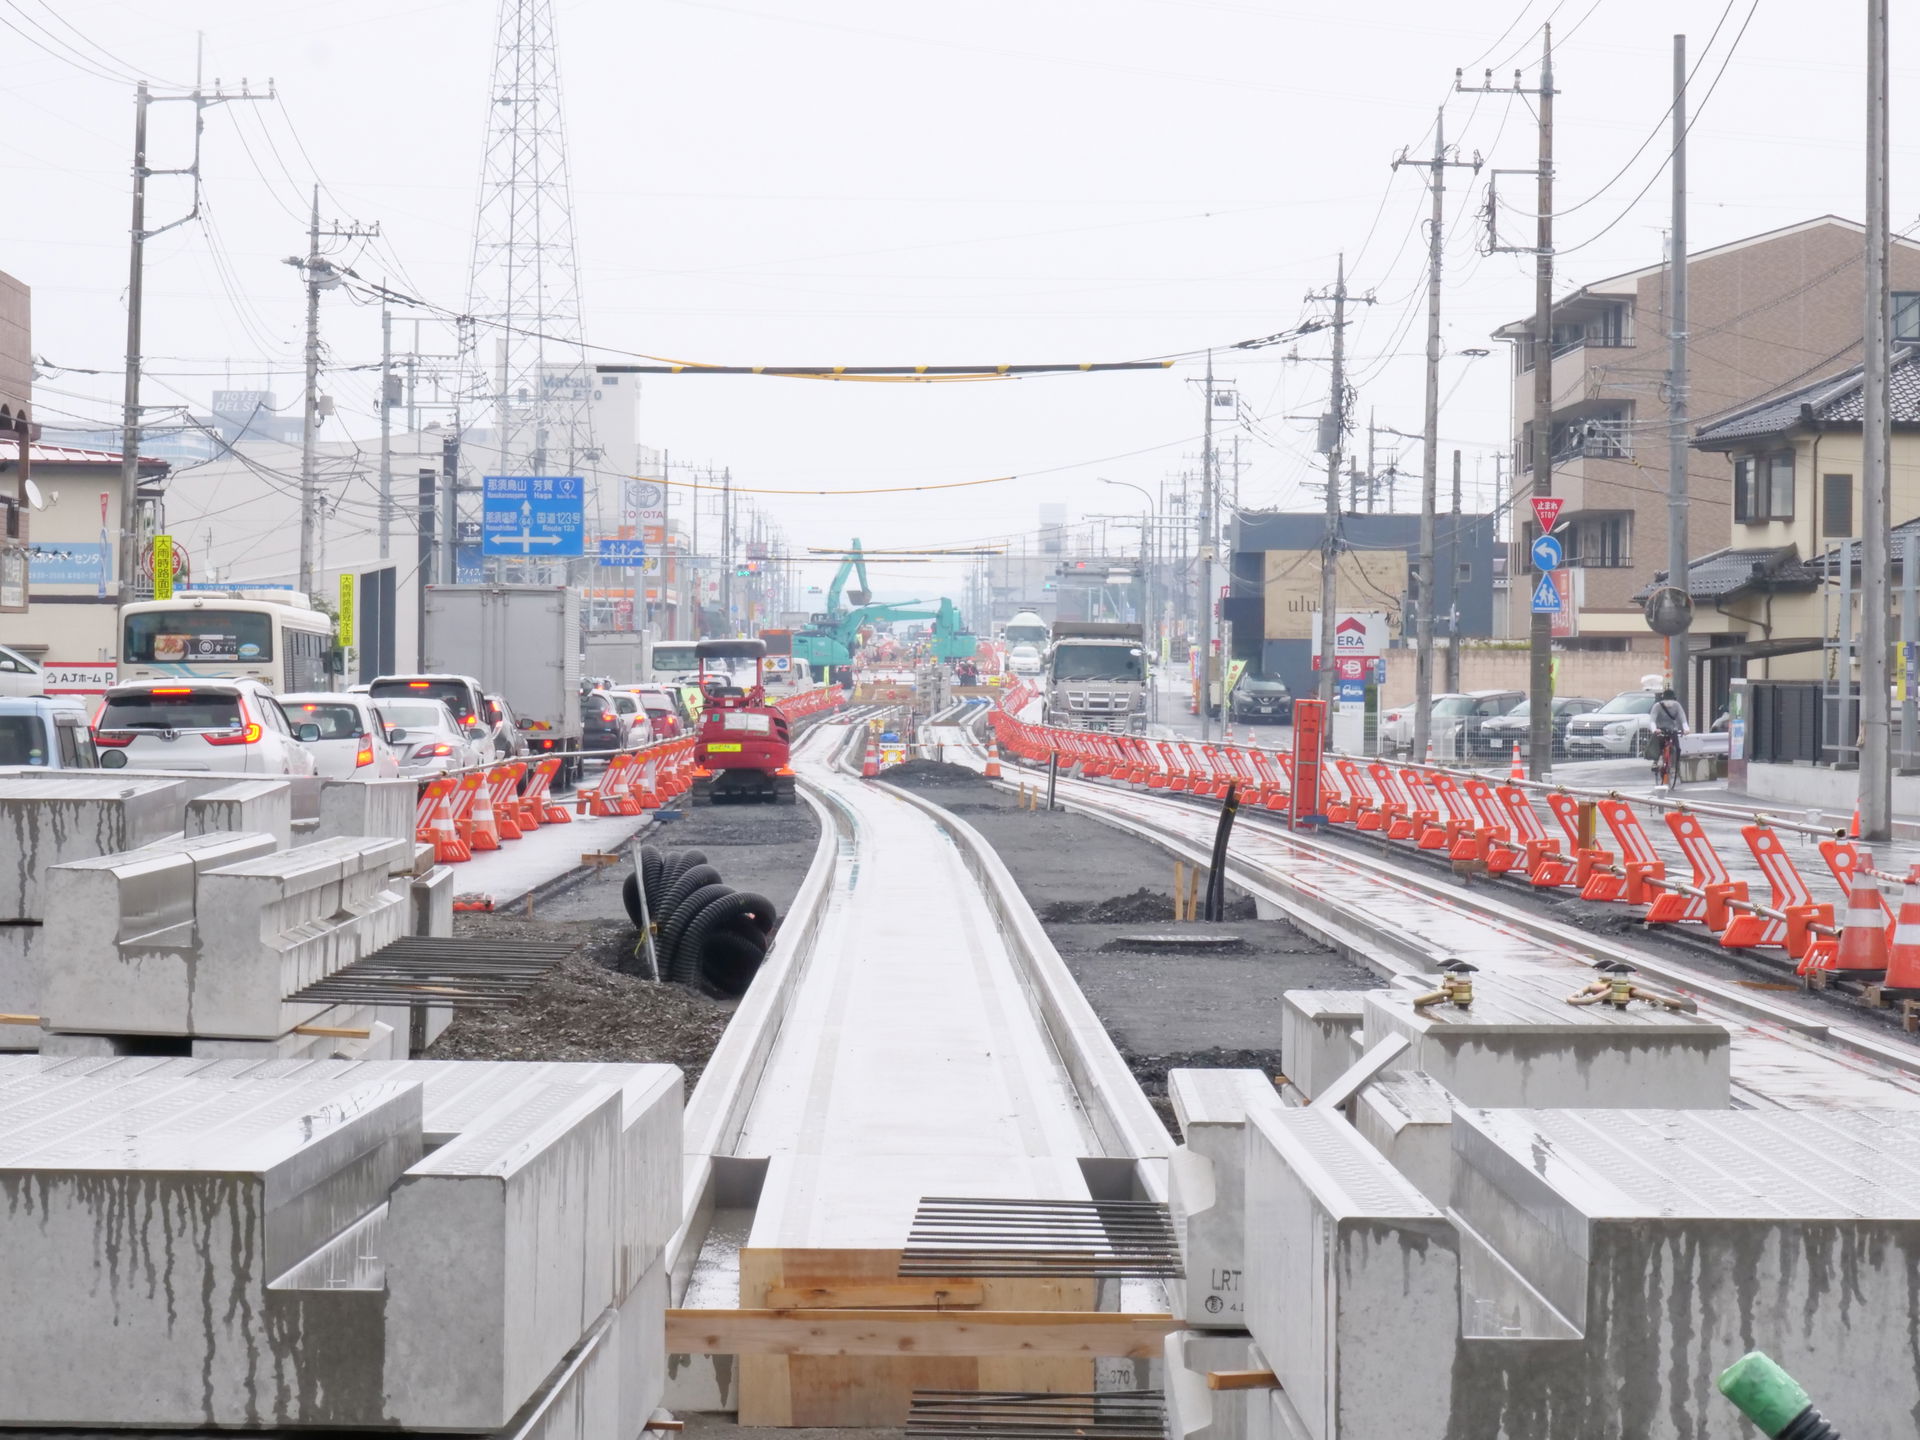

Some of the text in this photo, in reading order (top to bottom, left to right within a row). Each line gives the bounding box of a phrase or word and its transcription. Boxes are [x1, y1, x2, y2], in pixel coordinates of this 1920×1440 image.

[220, 392, 261, 401] HOTEL
[533, 479, 553, 491] 芳賀
[563, 482, 570, 490] 4
[534, 492, 553, 500] Haga
[1537, 501, 1558, 510] 止まれ
[536, 512, 581, 524] 国道123号
[1540, 511, 1556, 519] STOP
[1337, 636, 1365, 646] ERA
[60, 673, 102, 683] AJホーム
[105, 672, 114, 684] P
[1211, 1268, 1243, 1292] LRT
[1110, 1369, 1131, 1385] 370
